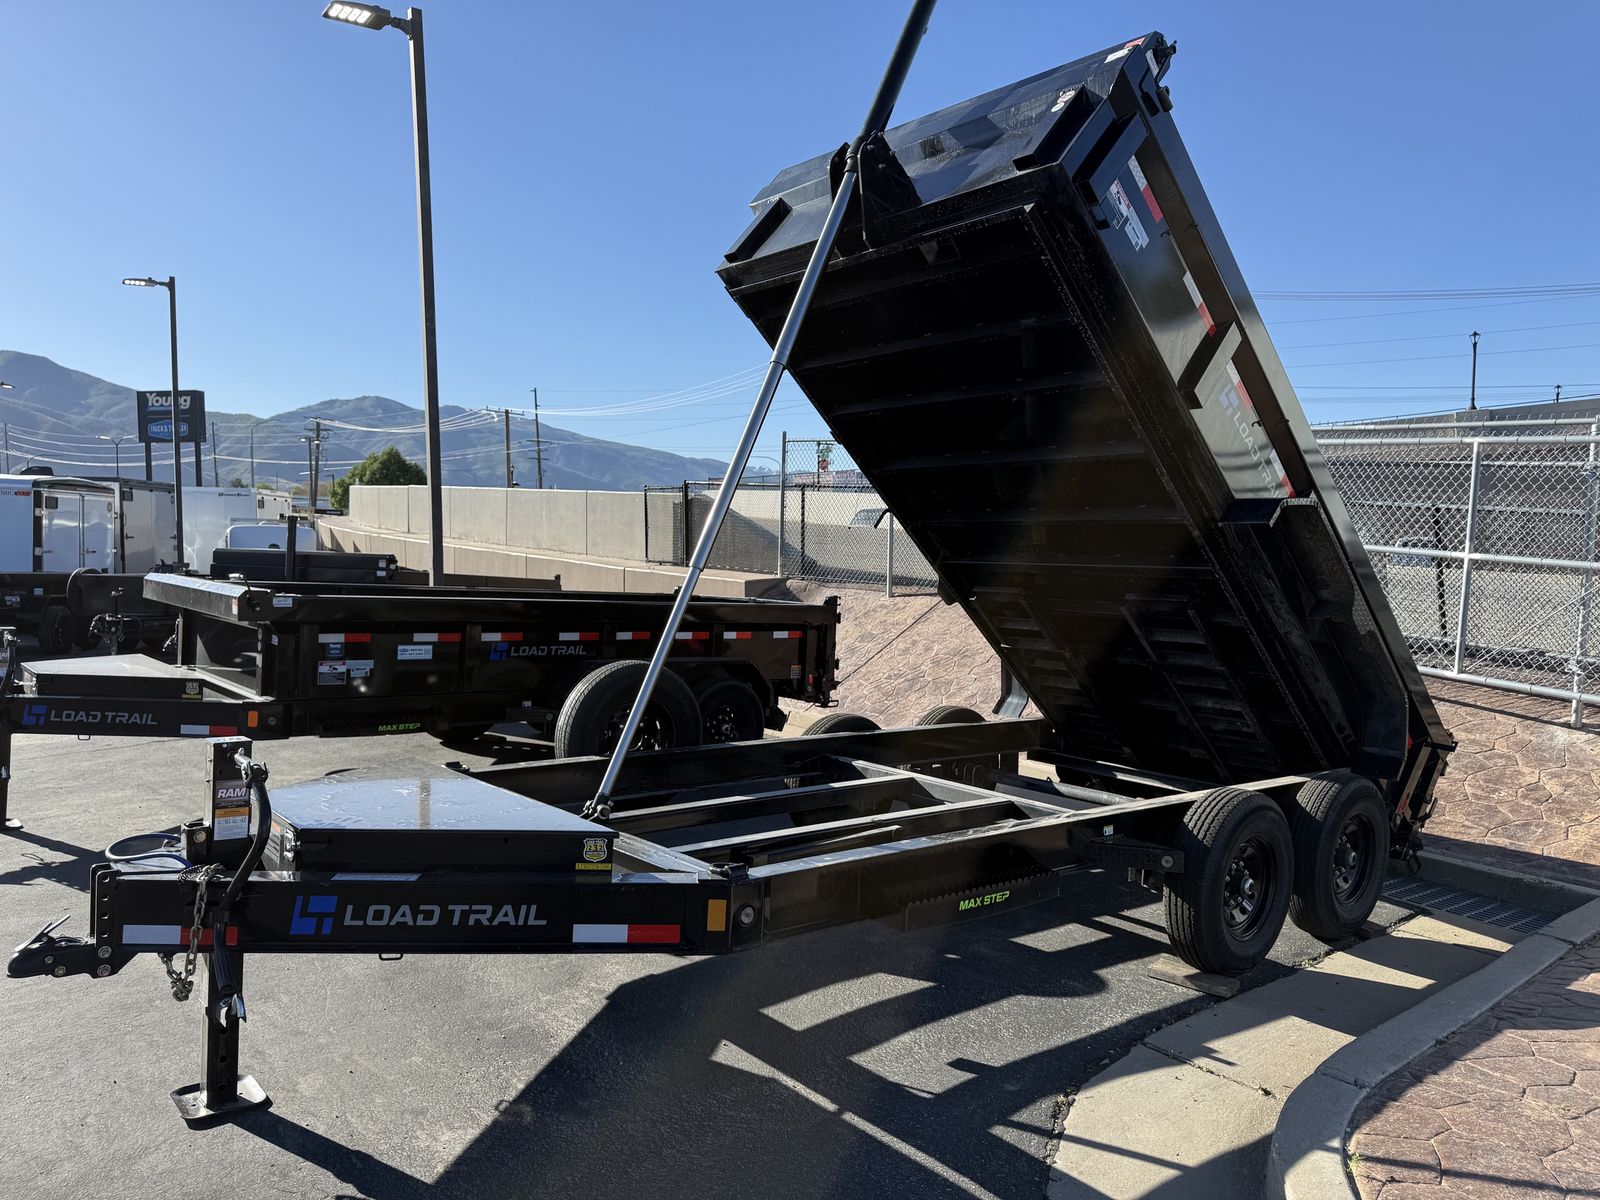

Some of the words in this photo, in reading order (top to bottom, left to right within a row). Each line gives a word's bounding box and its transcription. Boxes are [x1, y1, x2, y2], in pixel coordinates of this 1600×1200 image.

[145, 392, 191, 410] Youg
[1233, 411, 1260, 461] LOAD
[1258, 458, 1281, 498] TRAI
[510, 646, 548, 657] LOAD
[550, 645, 587, 656] TRAIL
[50, 710, 101, 723] LOAD
[104, 711, 158, 725] TRAIL
[217, 787, 246, 799] RAM
[959, 896, 982, 911] MAX
[983, 890, 1010, 906] STEP
[343, 904, 441, 926] LOAD
[448, 904, 547, 926] TRAIL
